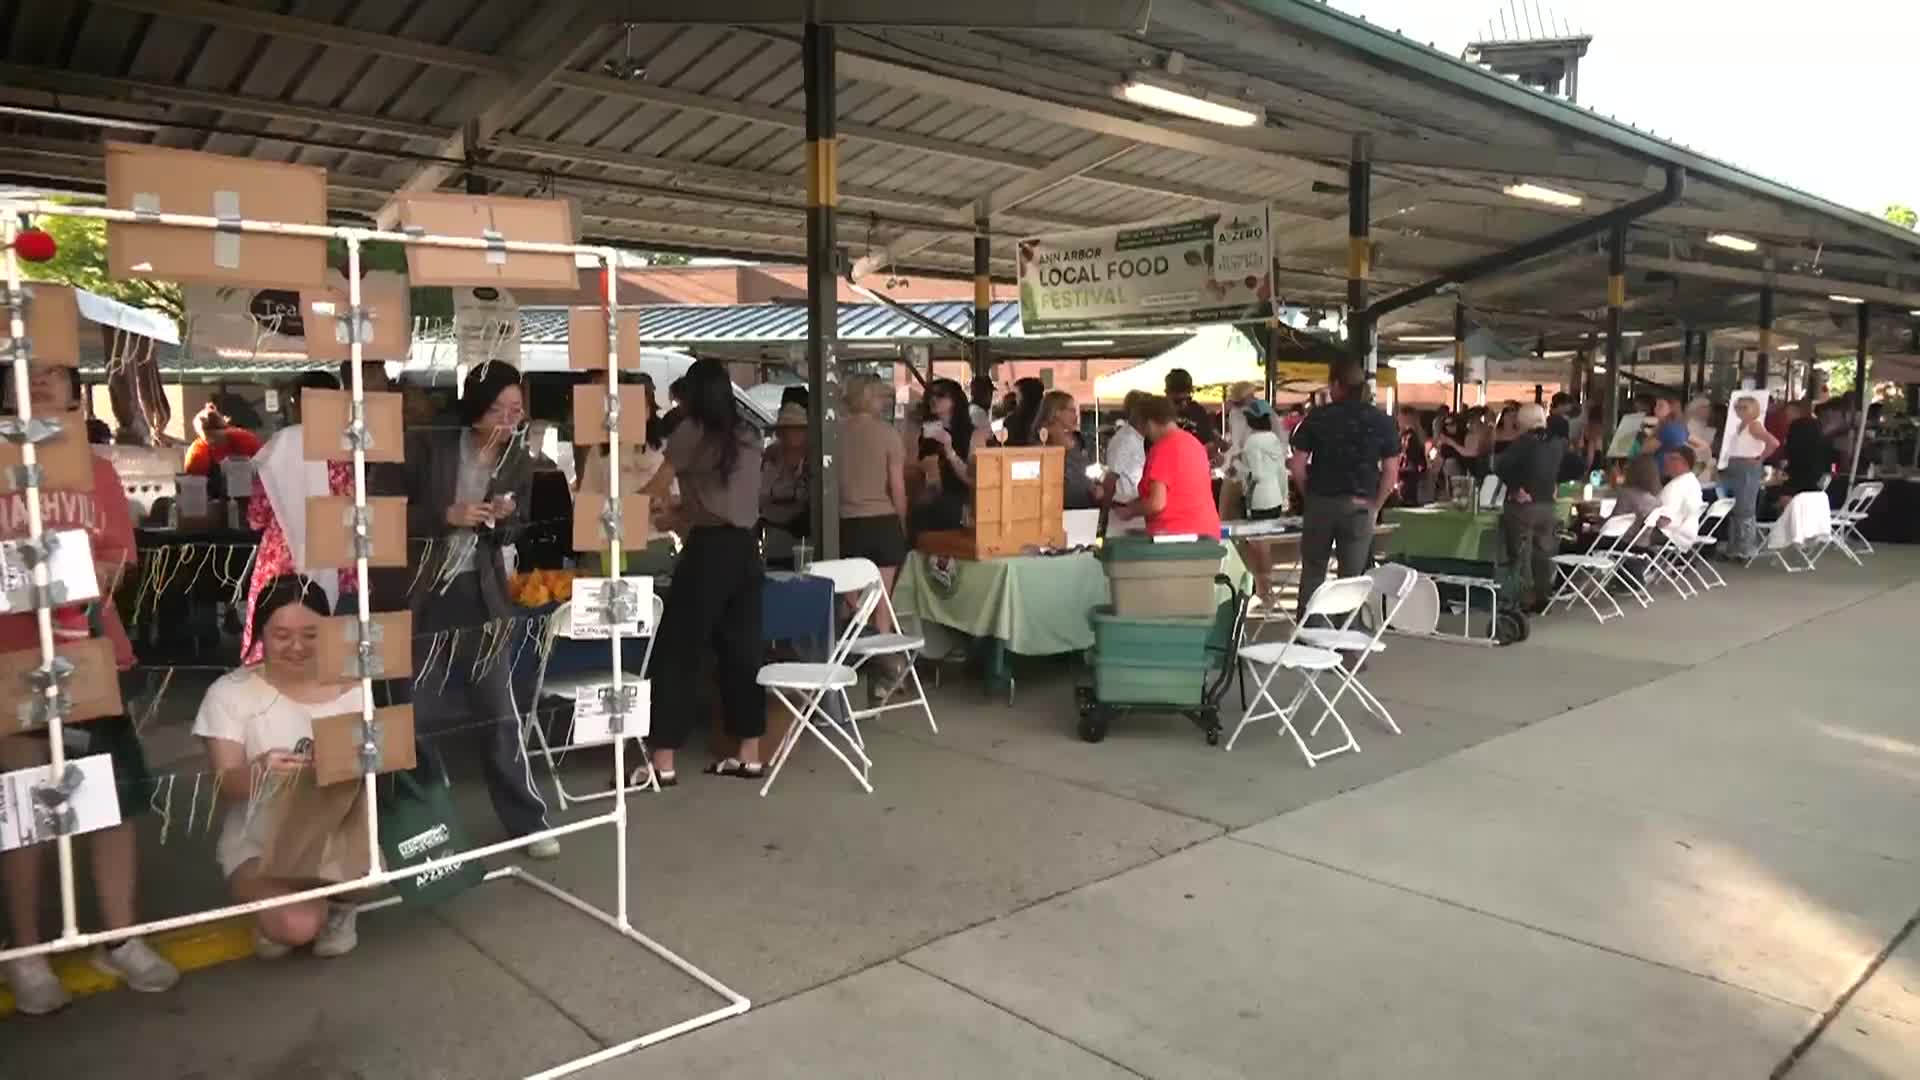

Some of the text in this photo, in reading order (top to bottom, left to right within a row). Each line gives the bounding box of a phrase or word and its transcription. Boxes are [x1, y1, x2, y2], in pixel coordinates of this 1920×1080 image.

[1039, 247, 1102, 265] ANN ARBOR
[1040, 255, 1169, 287] LOCAL FOOD
[1041, 286, 1127, 310] FESTIVAL
